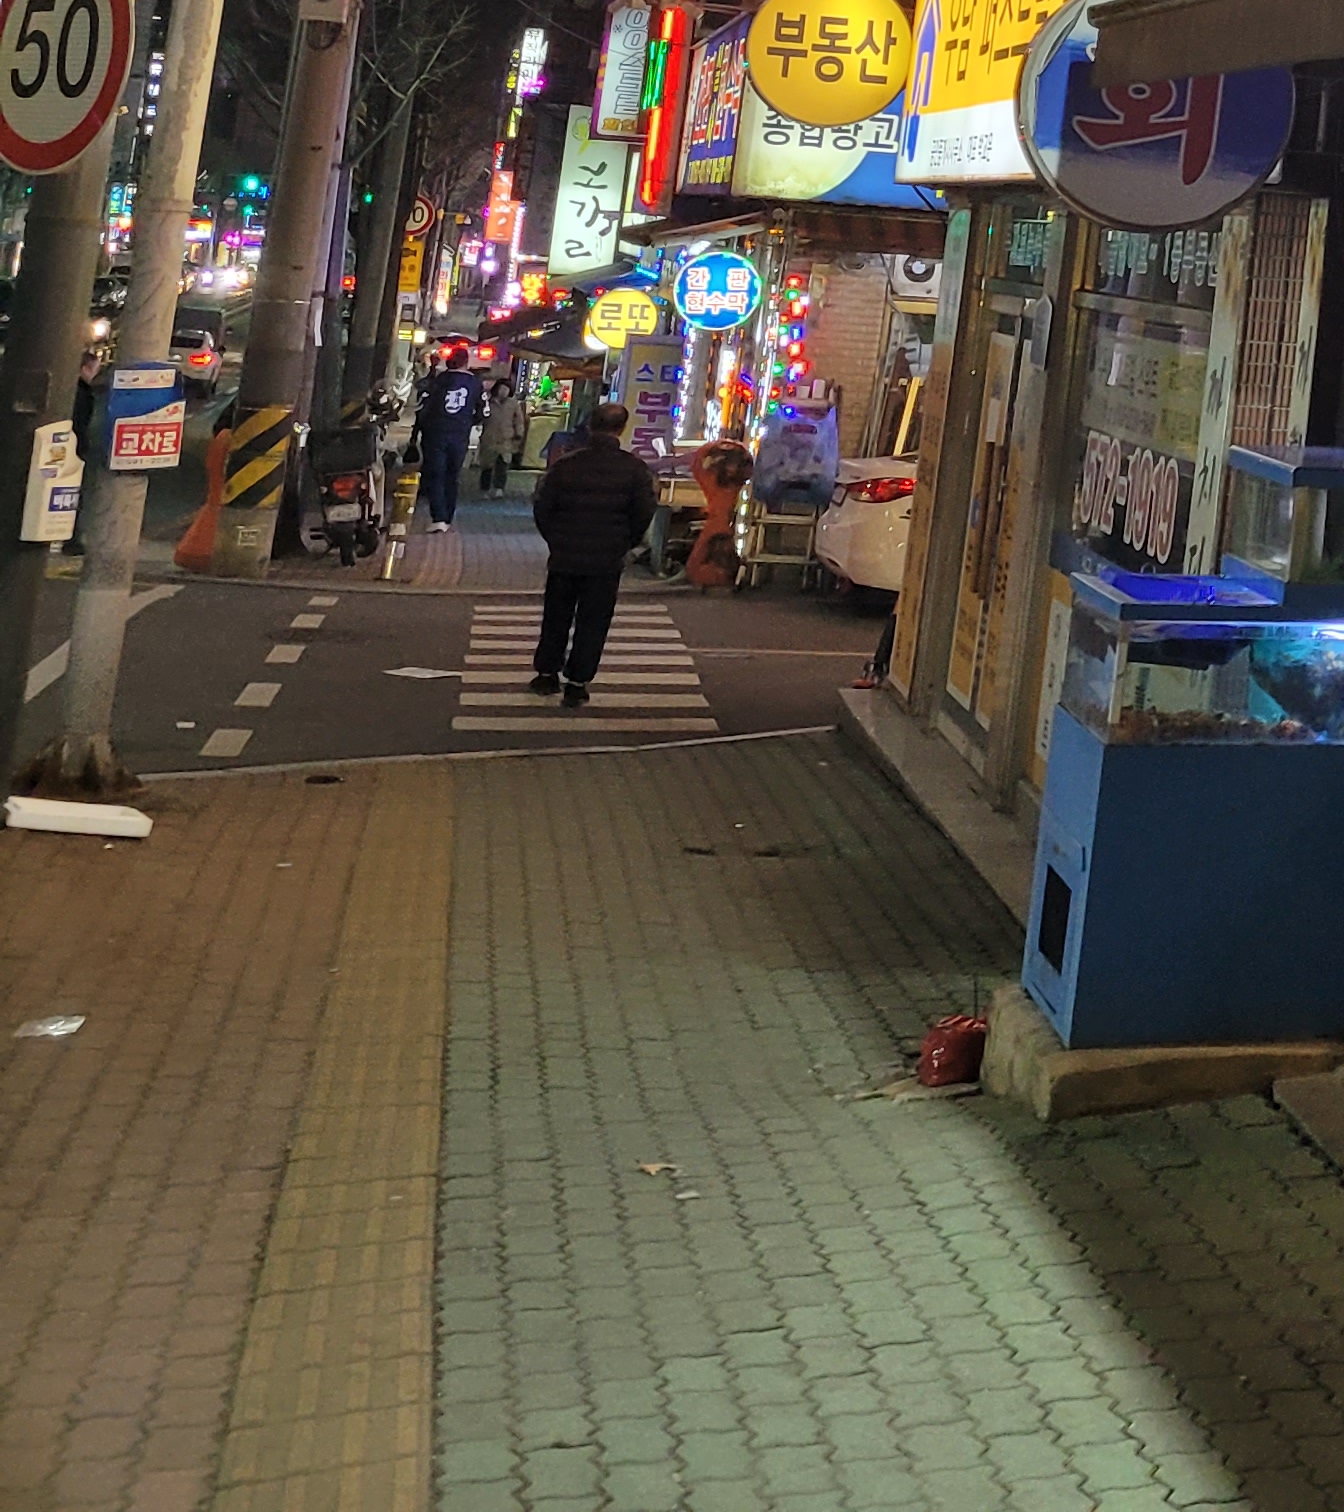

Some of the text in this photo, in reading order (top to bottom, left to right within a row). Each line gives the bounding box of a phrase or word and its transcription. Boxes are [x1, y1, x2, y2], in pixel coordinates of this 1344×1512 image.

[766, 11, 898, 85] 부동산
[686, 267, 749, 290] 간판
[685, 291, 749, 315] 현수막
[597, 302, 650, 333] 로또
[119, 431, 177, 455] 교차로
[1080, 429, 1179, 565] 572-1919
